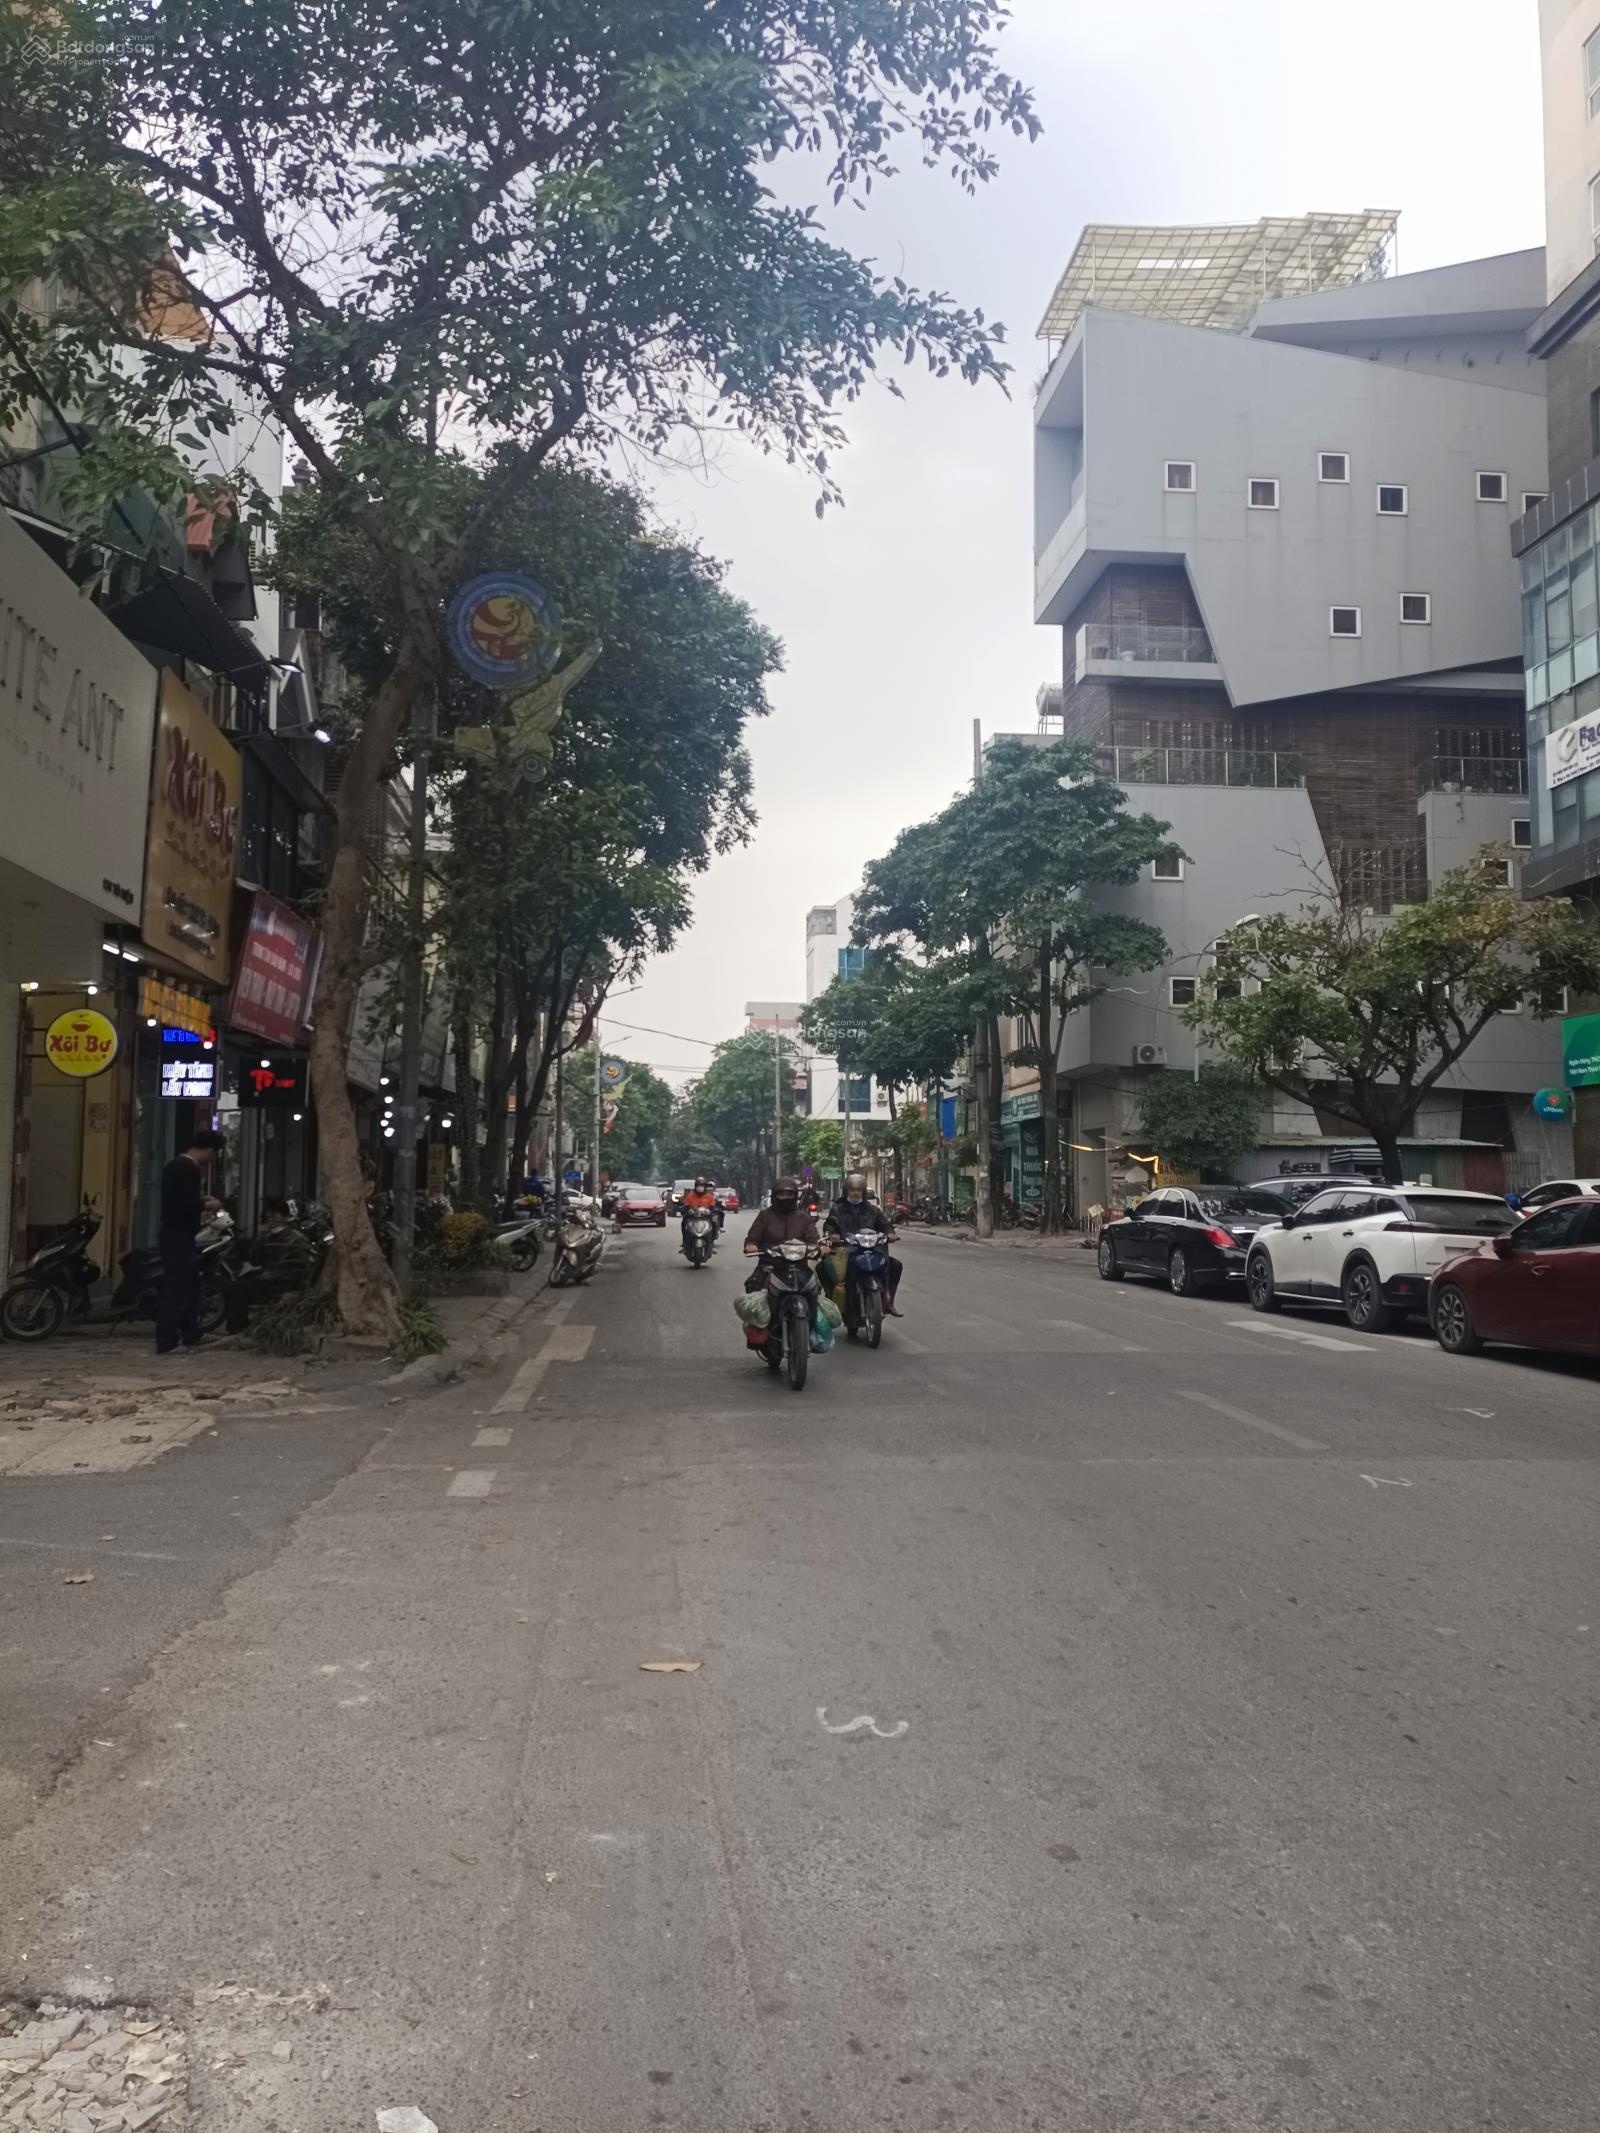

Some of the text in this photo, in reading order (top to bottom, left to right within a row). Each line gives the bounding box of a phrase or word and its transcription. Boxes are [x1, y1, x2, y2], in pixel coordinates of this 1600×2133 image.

[60, 668, 124, 771] ANT
[49, 1035, 78, 1053] Xôi
[85, 1035, 112, 1059] Bự
